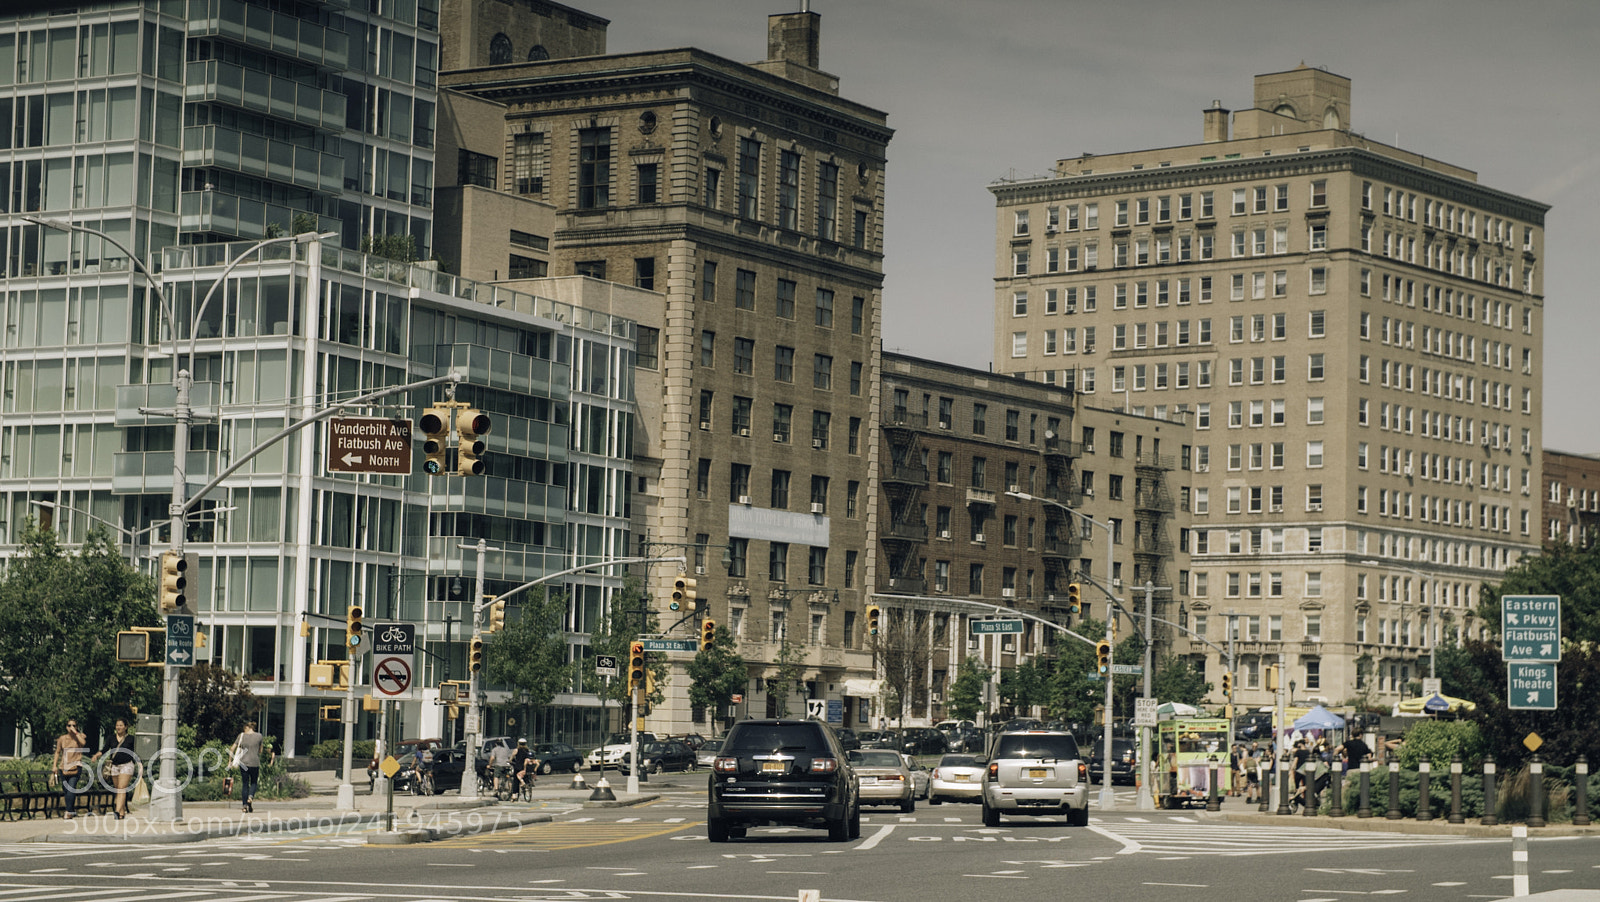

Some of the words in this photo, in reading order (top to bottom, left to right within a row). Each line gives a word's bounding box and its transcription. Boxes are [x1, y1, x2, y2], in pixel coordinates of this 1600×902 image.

[333, 423, 387, 435] Vanderbilt
[389, 424, 409, 437] Ave
[338, 436, 381, 450] Flatbush
[384, 438, 403, 451] Ave
[369, 454, 400, 467] NORTH
[1505, 600, 1556, 611] Eastern
[1523, 614, 1556, 627] Pkwy
[981, 623, 994, 631] Plaza
[995, 623, 1001, 631] St
[1002, 622, 1013, 631] East
[1506, 630, 1556, 641] Flatbush
[376, 644, 392, 652] BIKE
[393, 644, 412, 652] PATH
[649, 641, 665, 649] Plaza
[673, 642, 686, 650] East
[1511, 645, 1533, 655] Ave
[1518, 667, 1547, 680] Kings
[1512, 679, 1552, 690] Theatre
